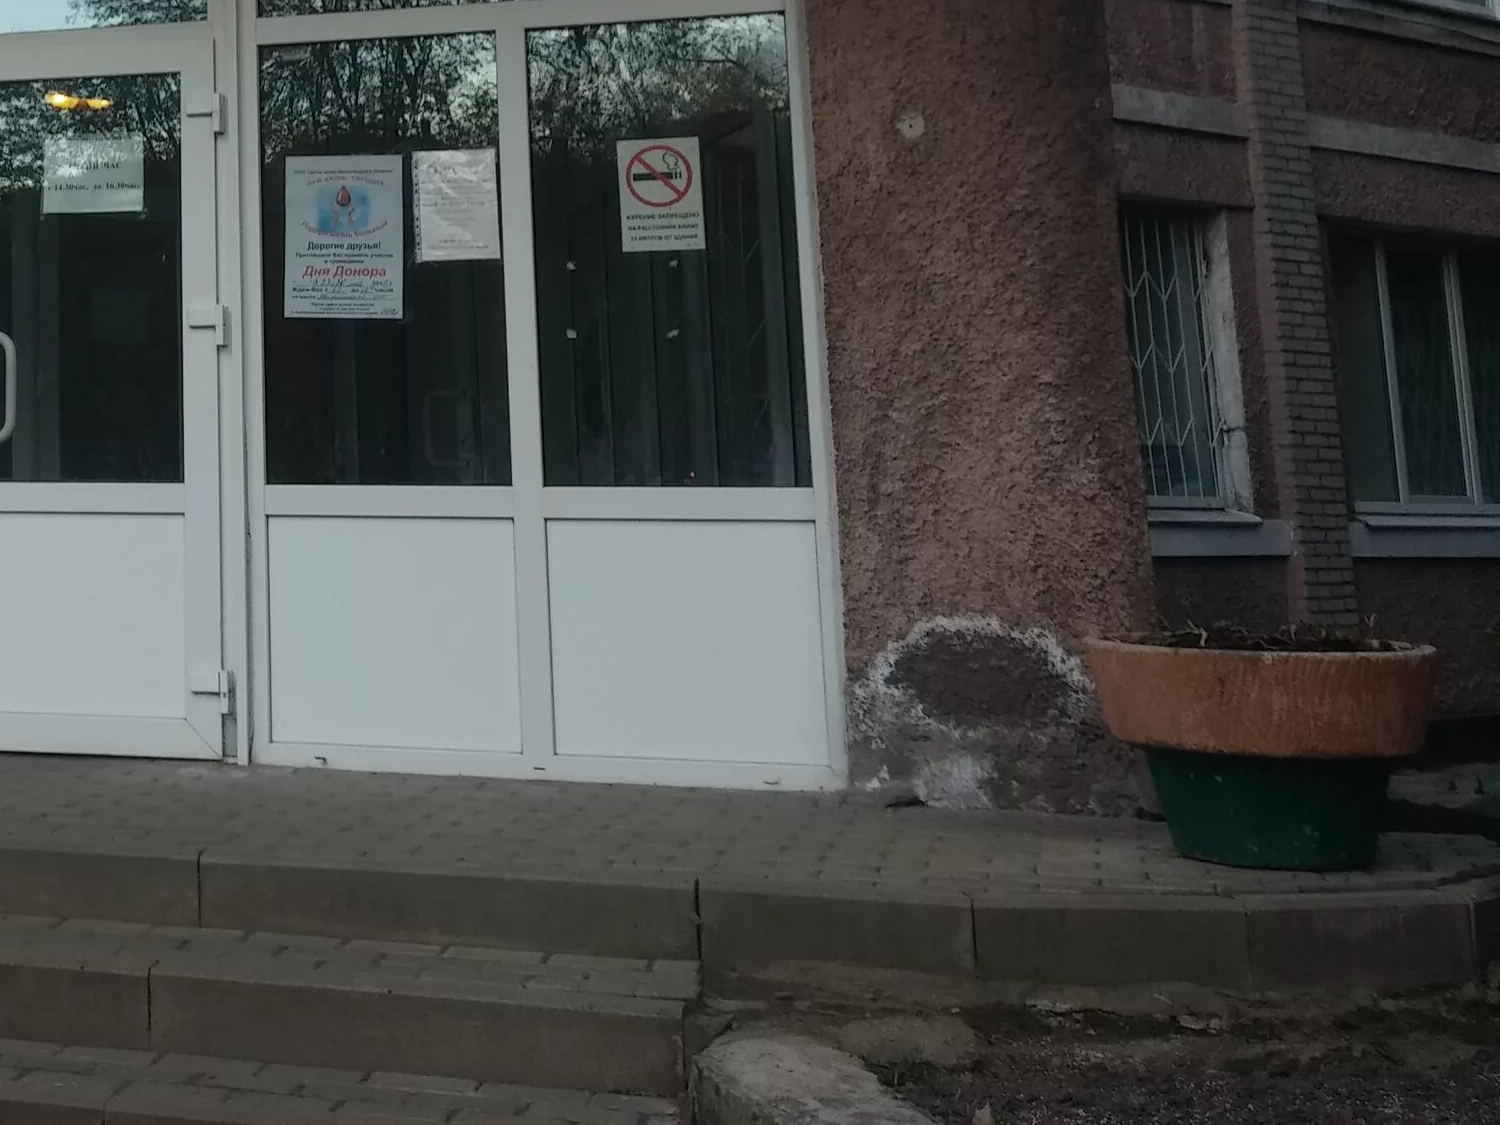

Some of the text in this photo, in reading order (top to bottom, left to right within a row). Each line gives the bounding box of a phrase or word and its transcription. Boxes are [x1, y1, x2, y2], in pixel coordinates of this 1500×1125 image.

[308, 241, 381, 252] Дорогие друзья!
[302, 265, 387, 279] Дня Донора
